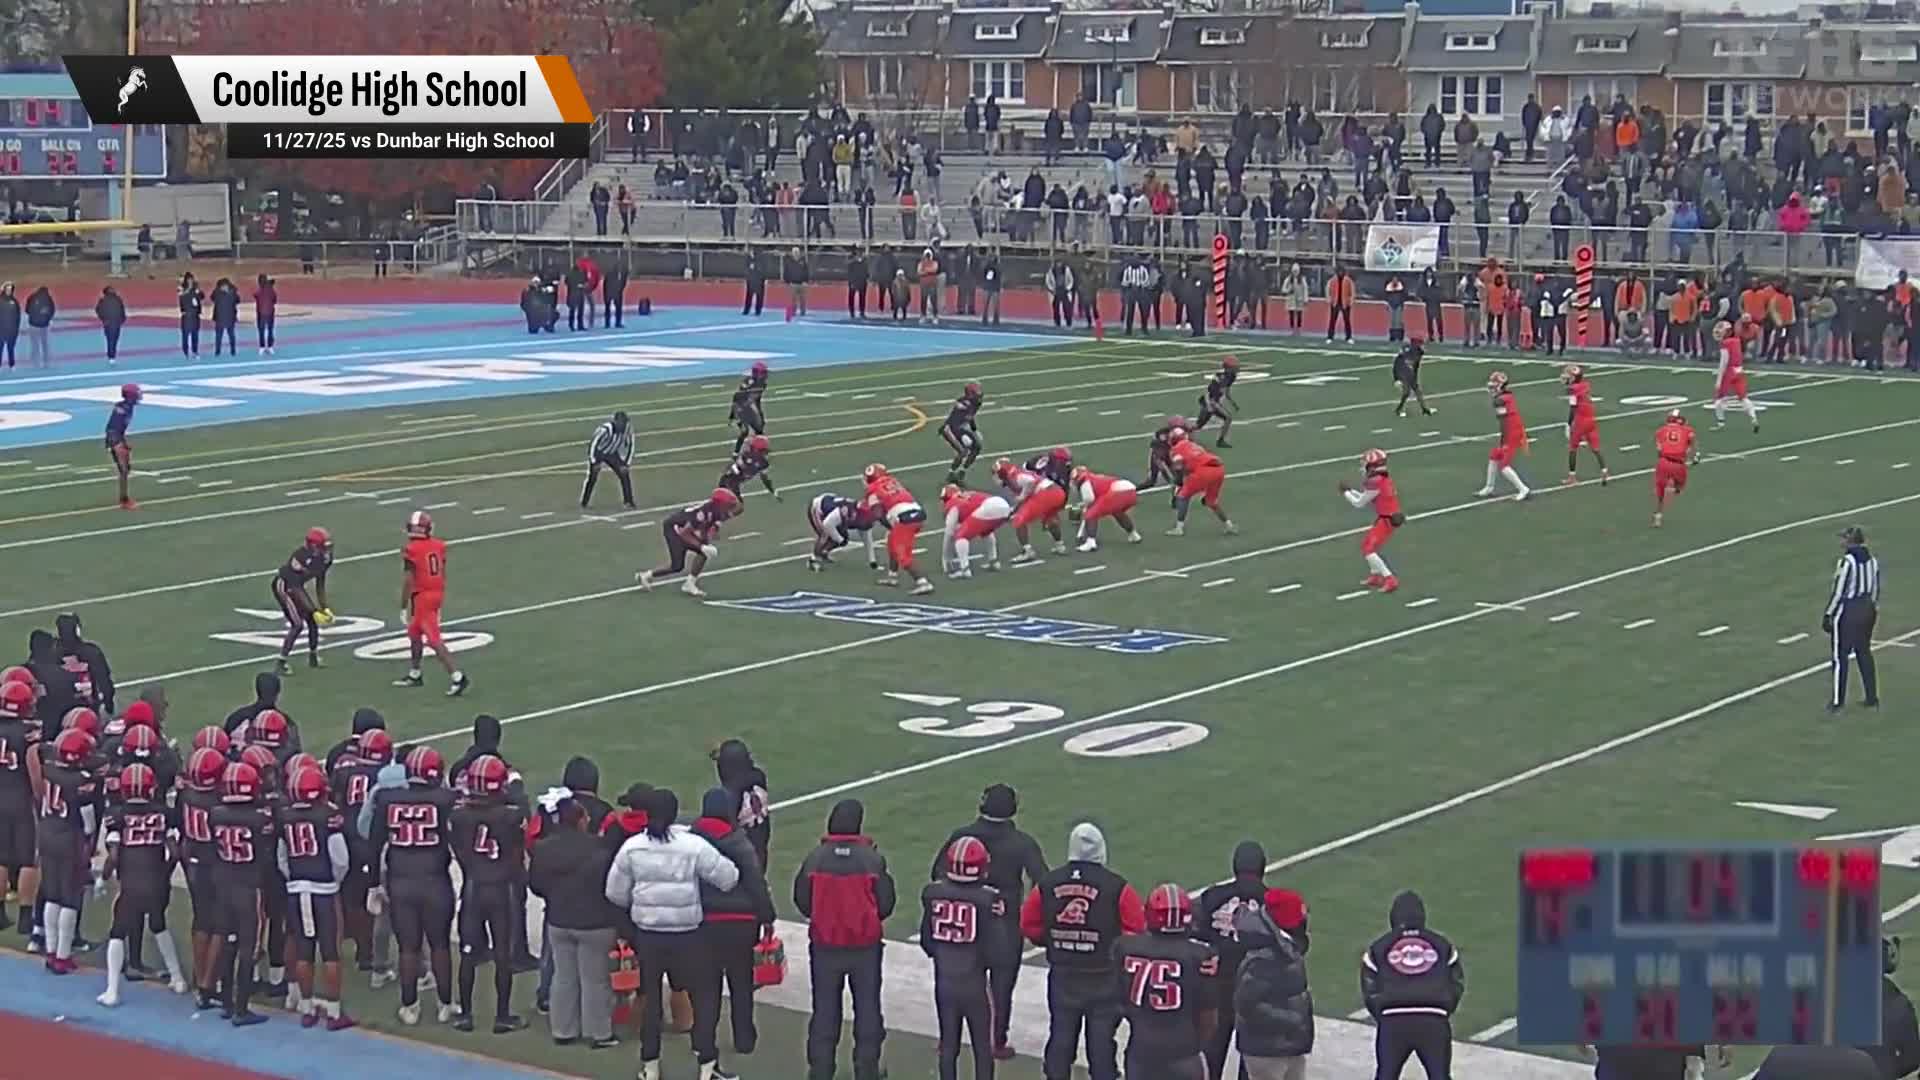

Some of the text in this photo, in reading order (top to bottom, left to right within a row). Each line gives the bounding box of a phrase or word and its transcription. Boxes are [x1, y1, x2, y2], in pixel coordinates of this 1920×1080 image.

[428, 552, 440, 577] 0
[898, 701, 1209, 757] 30
[122, 813, 167, 846] 22
[215, 824, 255, 864] 35
[387, 803, 440, 847] 52
[473, 824, 500, 860] 4
[931, 899, 978, 943] 29
[1124, 955, 1182, 1011] 75
